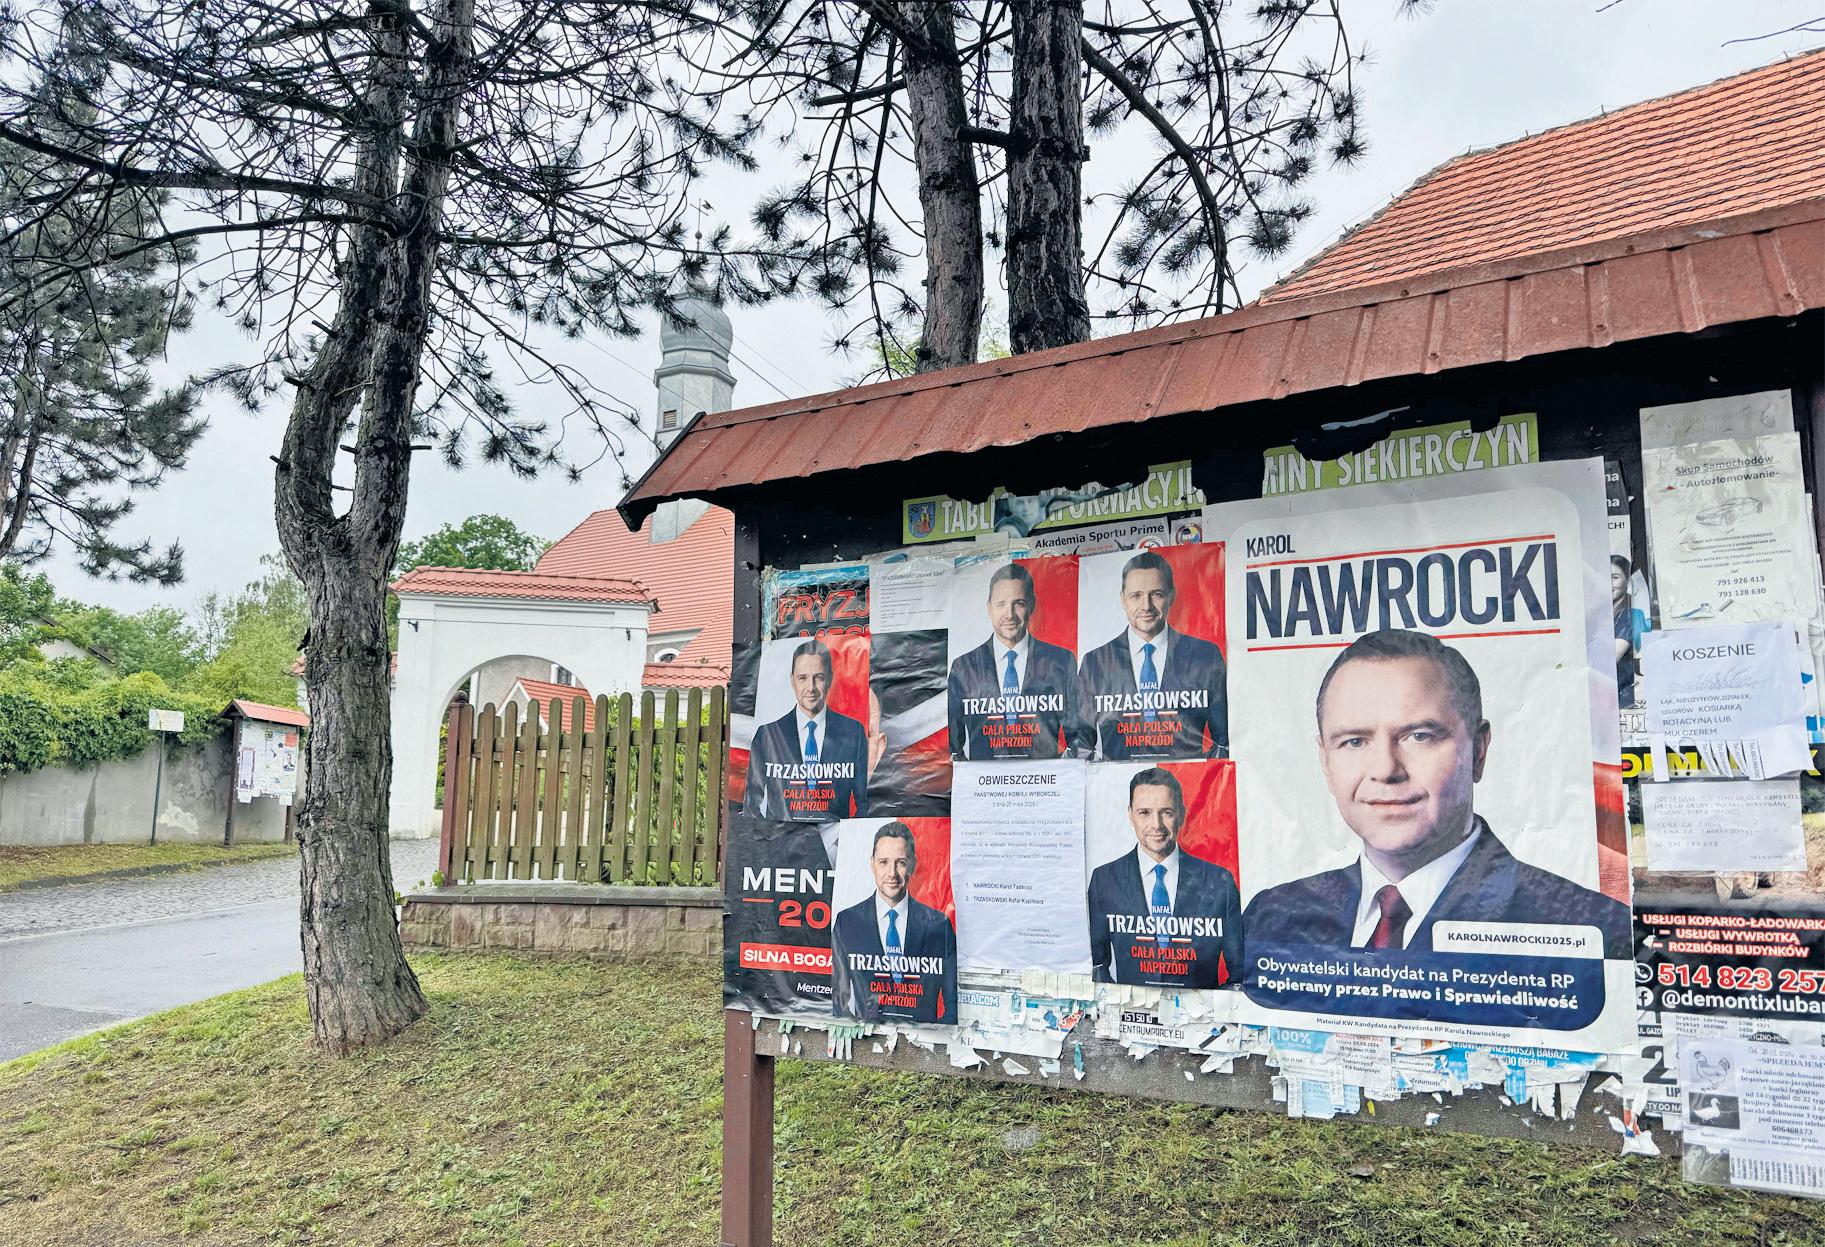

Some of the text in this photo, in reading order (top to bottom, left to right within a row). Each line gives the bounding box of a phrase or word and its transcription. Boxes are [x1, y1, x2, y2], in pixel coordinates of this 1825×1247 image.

[1337, 421, 1530, 488] SIEKIERCZYN
[1675, 455, 1774, 476] Skup Samochodów
[942, 492, 1009, 535] TABLI
[1035, 522, 1165, 549] Akademia Sportu Prime
[1246, 534, 1296, 558] KAROL
[1751, 575, 1765, 583] 413
[1246, 542, 1561, 640] NAWROCKI
[1672, 643, 1757, 662] KOSZENIE
[963, 694, 1064, 715] TRZASKOWSKI
[1095, 690, 1209, 713] TRZASKOWSKI
[1698, 703, 1743, 712] KOSIARKĄ
[1714, 715, 1732, 723] LUB
[982, 722, 1041, 735] CAŁA POLSKA
[1117, 720, 1183, 734] CAŁA POLSKA
[989, 735, 1033, 748] NAPRZÓD!
[1125, 733, 1174, 747] NAPRZÓD!
[765, 762, 854, 779] TRZASKOWSKI
[978, 774, 1057, 786] OBWIESZCZENIE
[783, 788, 836, 799] CAŁA POLSKA
[790, 800, 830, 811] NAPRZÓD!
[1152, 905, 1171, 914] RAFAŁ
[1106, 914, 1223, 937] TRZASKOWSKI
[1642, 914, 1686, 926] USŁUGI
[1448, 932, 1586, 947] KAROLNAWROCKI2025.pl
[1675, 928, 1800, 945] USŁUGI WYWROTKĄ
[743, 949, 792, 965] SILNA
[1131, 945, 1197, 960] CAŁA POLSKA
[1668, 942, 1809, 957] ROZBIÓRKI BUDYNKÓW
[848, 953, 943, 975] TRZASKOWSKI
[1139, 960, 1179, 975] NAPRZÓD!
[1257, 957, 1575, 988] Obywatelski kandydat na Prezydenta RP
[1658, 963, 1712, 987] 514
[1717, 966, 1772, 991] 823
[870, 981, 924, 995] CAŁA POLSKA
[1258, 975, 1579, 1010] Popierany przez Prawo i Sprawiedliwość
[878, 994, 917, 1008] NAPRZÓD!
[1316, 1018, 1341, 1026] Materiał
[1354, 1021, 1388, 1030] Kandydata
[1398, 1023, 1434, 1033] Prezydenta
[1444, 1027, 1466, 1035] Karola
[1466, 1029, 1511, 1039] Nawrockiego
[1276, 1030, 1312, 1045] 100%
